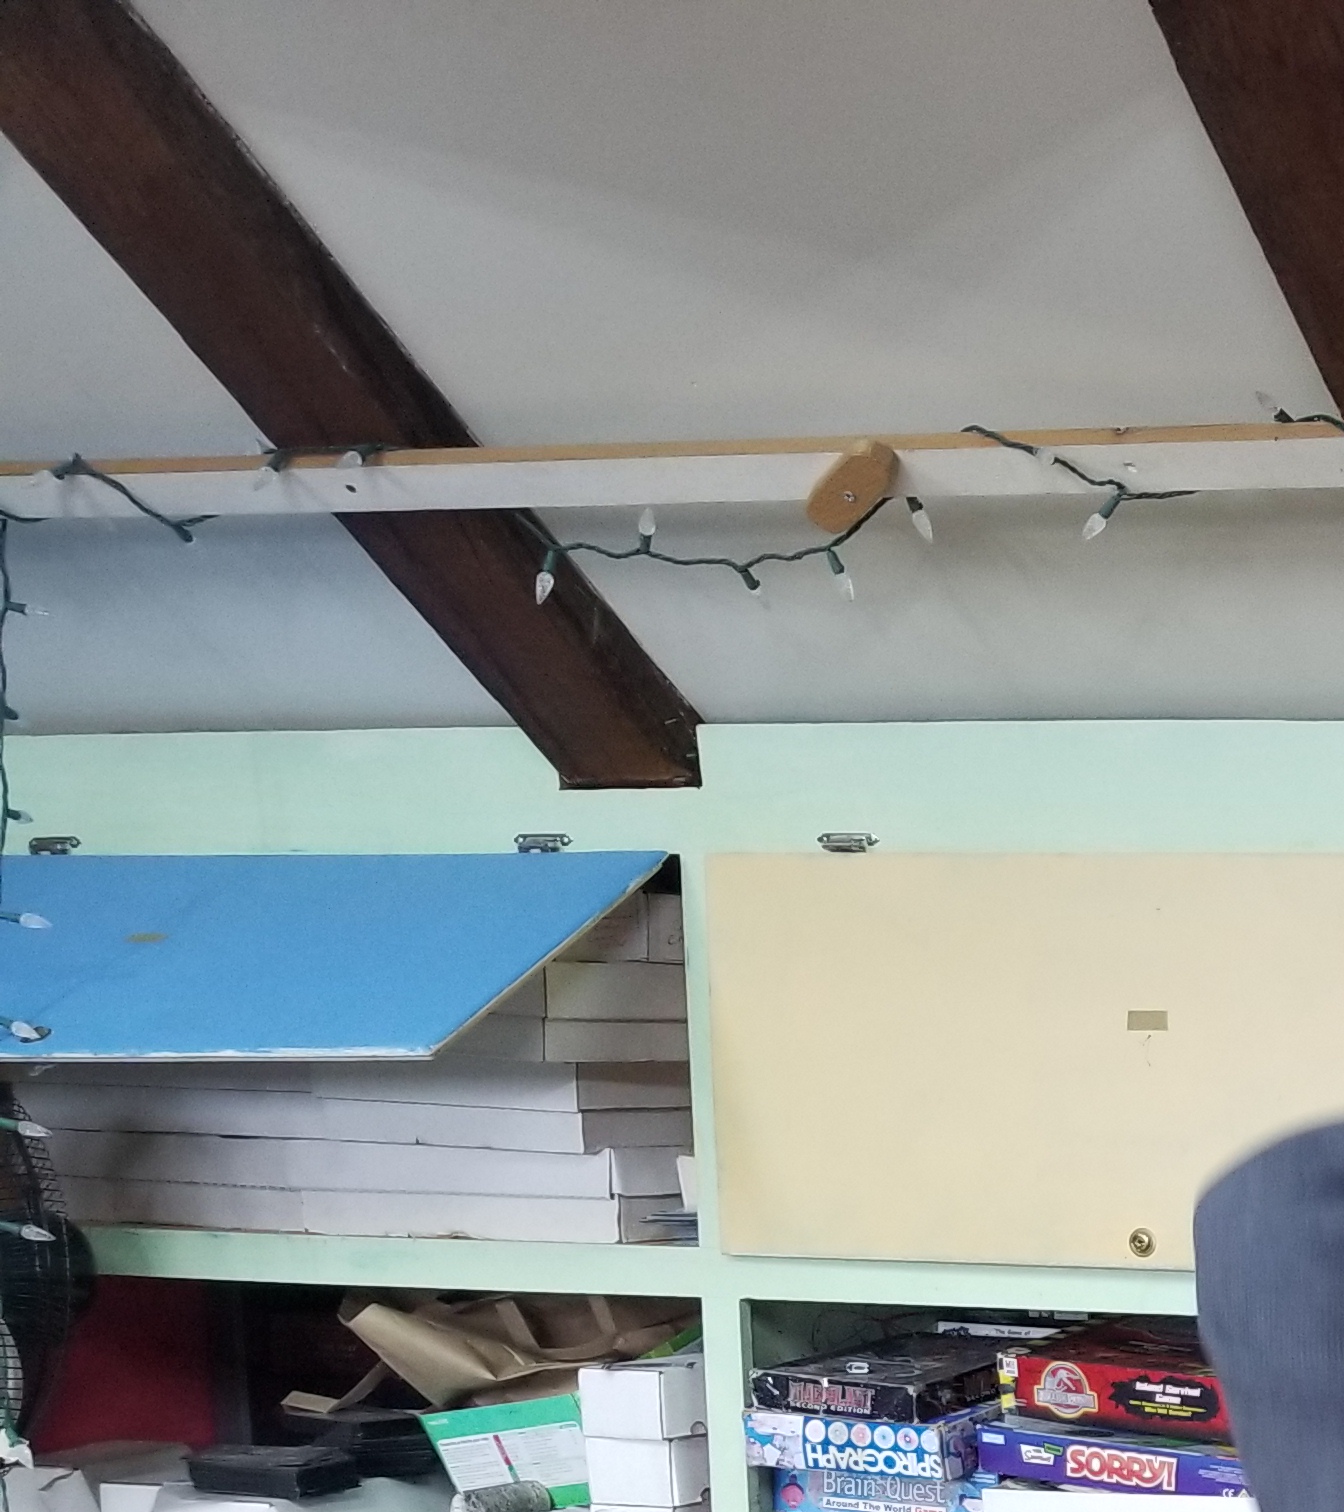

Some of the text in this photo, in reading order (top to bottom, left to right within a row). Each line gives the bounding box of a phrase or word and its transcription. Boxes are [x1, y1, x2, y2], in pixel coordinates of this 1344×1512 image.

[805, 1444, 943, 1479] SPIROGRAPH
[1067, 1445, 1177, 1491] SORRY!
[823, 1472, 946, 1504] Brain Quest
[825, 1499, 858, 1510] Around
[862, 1503, 881, 1512] The
